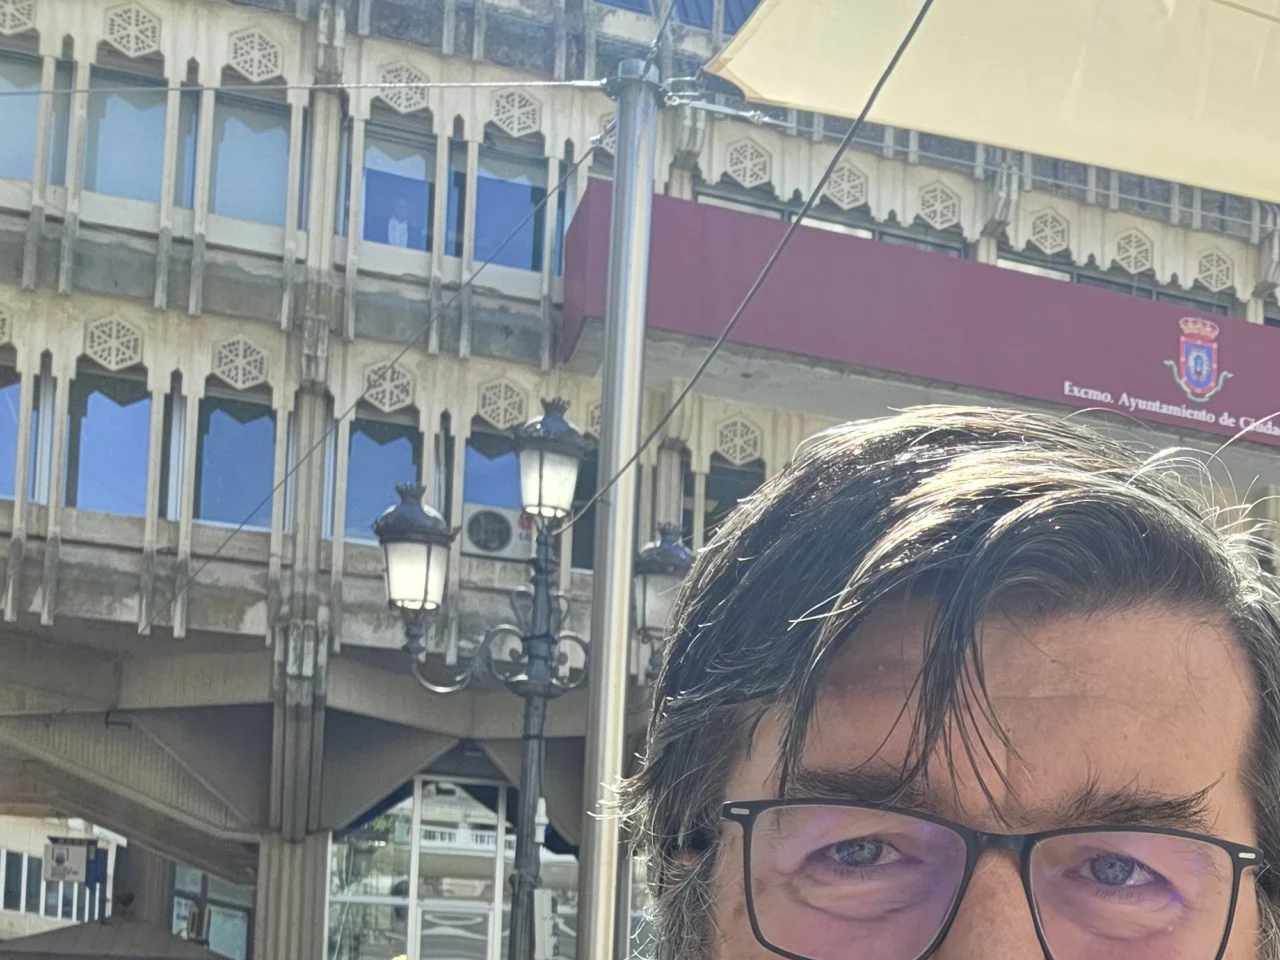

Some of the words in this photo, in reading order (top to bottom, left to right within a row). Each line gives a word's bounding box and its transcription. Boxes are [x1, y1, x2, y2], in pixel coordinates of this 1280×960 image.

[1063, 381, 1115, 404] Excmo.
[1118, 392, 1216, 425] Ayuntamiento
[1219, 412, 1236, 427] de
